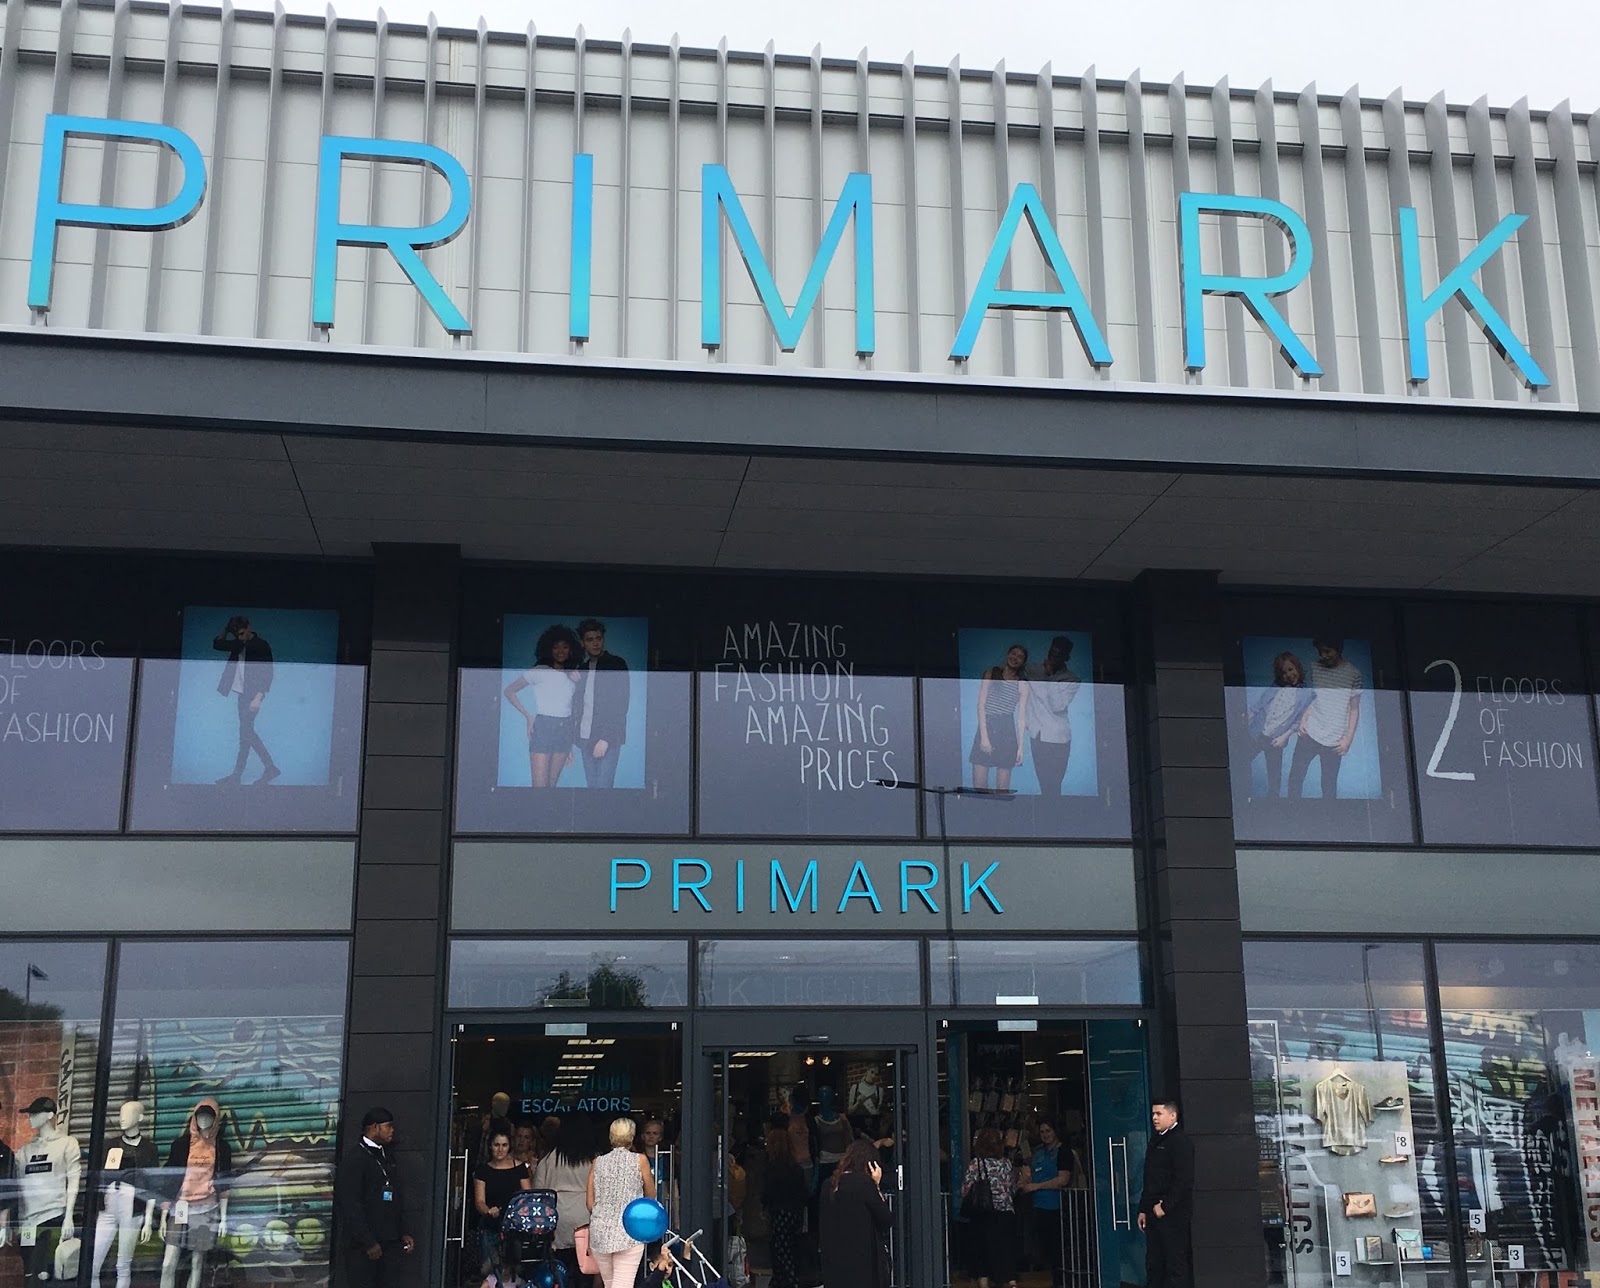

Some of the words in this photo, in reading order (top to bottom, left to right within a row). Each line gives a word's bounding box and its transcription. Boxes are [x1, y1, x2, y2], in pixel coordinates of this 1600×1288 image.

[27, 113, 1550, 389] PRIMARK
[723, 620, 846, 660] AMAZING
[714, 660, 862, 702] FASHION,
[1476, 676, 1566, 705] FLOORS
[0, 711, 114, 743] ASHION
[746, 702, 890, 746] AMAZING
[1424, 659, 1476, 781] 2
[1479, 708, 1508, 735] OF
[800, 745, 899, 791] PRICES
[1482, 740, 1584, 769] FASHION
[609, 858, 1004, 914] PRIMARK
[1396, 1136, 1407, 1147] £8
